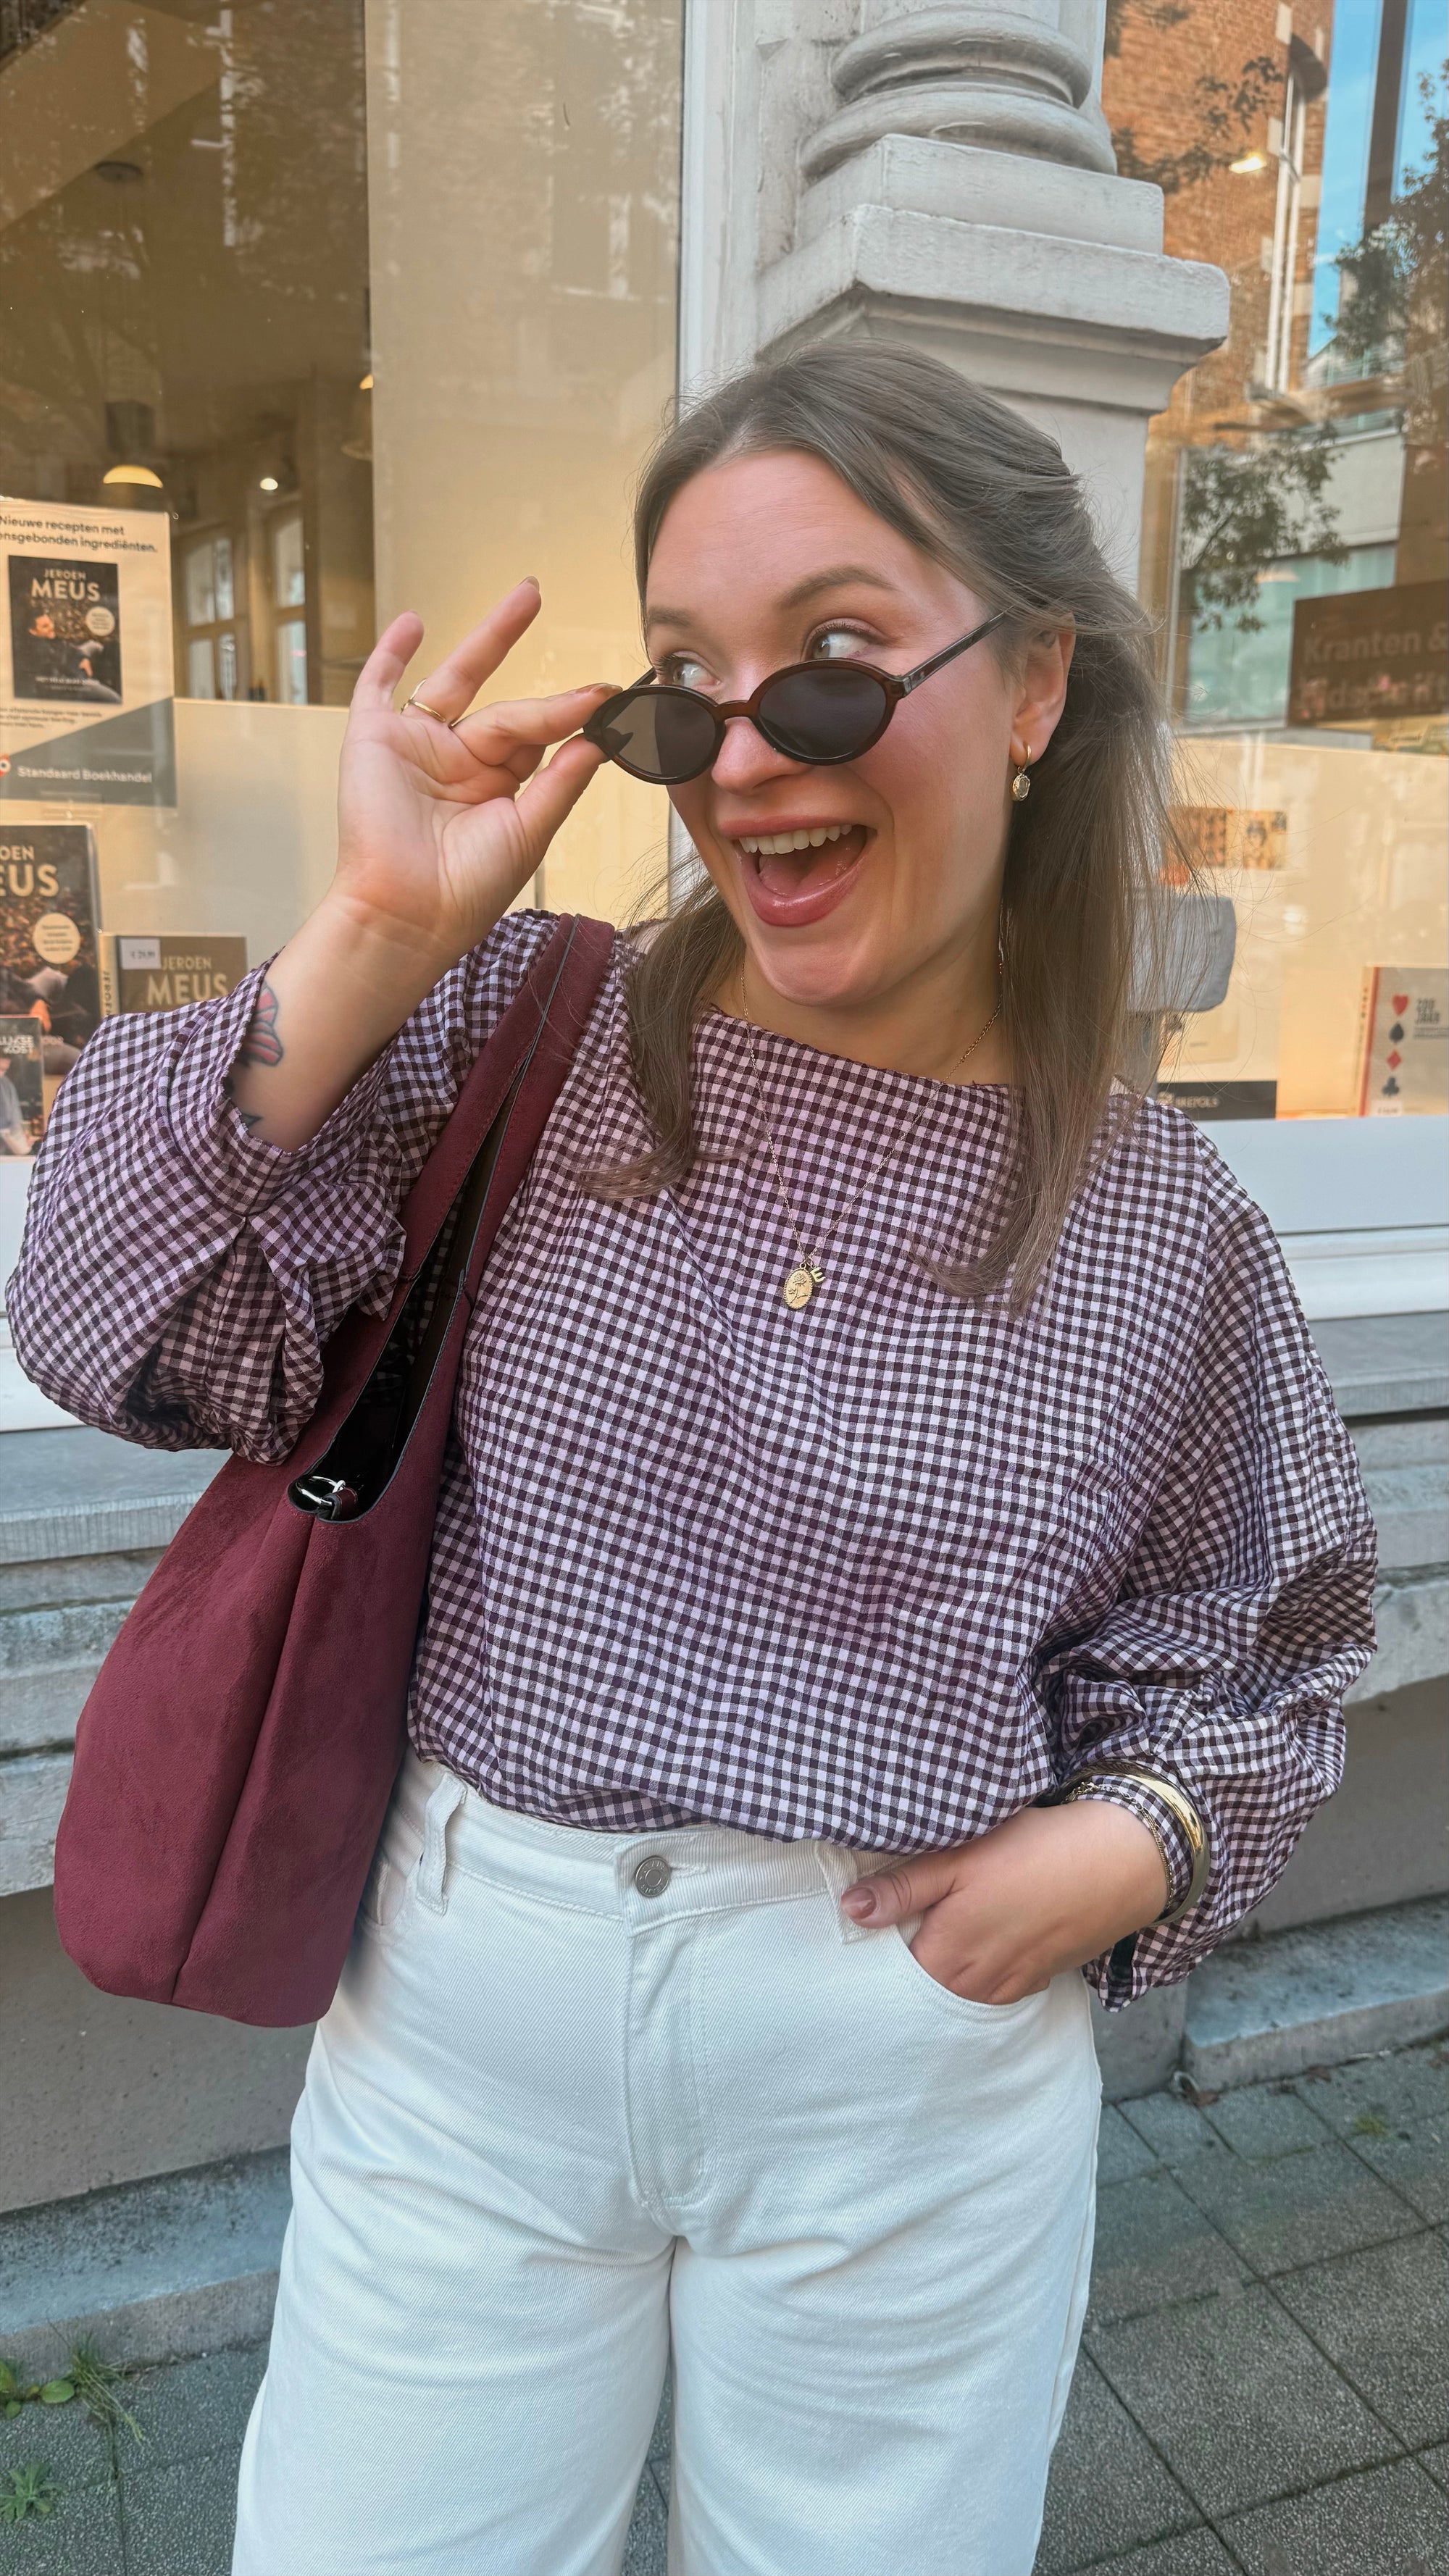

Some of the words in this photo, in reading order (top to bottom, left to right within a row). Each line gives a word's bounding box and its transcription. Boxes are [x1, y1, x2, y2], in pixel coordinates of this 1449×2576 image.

[0, 516, 42, 527] Nieuwe
[45, 521, 99, 535] recepten
[101, 524, 124, 535] met
[44, 569, 86, 580] JEROEN
[30, 578, 100, 601] MEUS
[1304, 629, 1422, 664] Kranten
[17, 766, 80, 780] Standaard
[83, 768, 151, 783] Boekhandel
[162, 956, 212, 971] JEROEN
[147, 973, 229, 1005] MEUS
